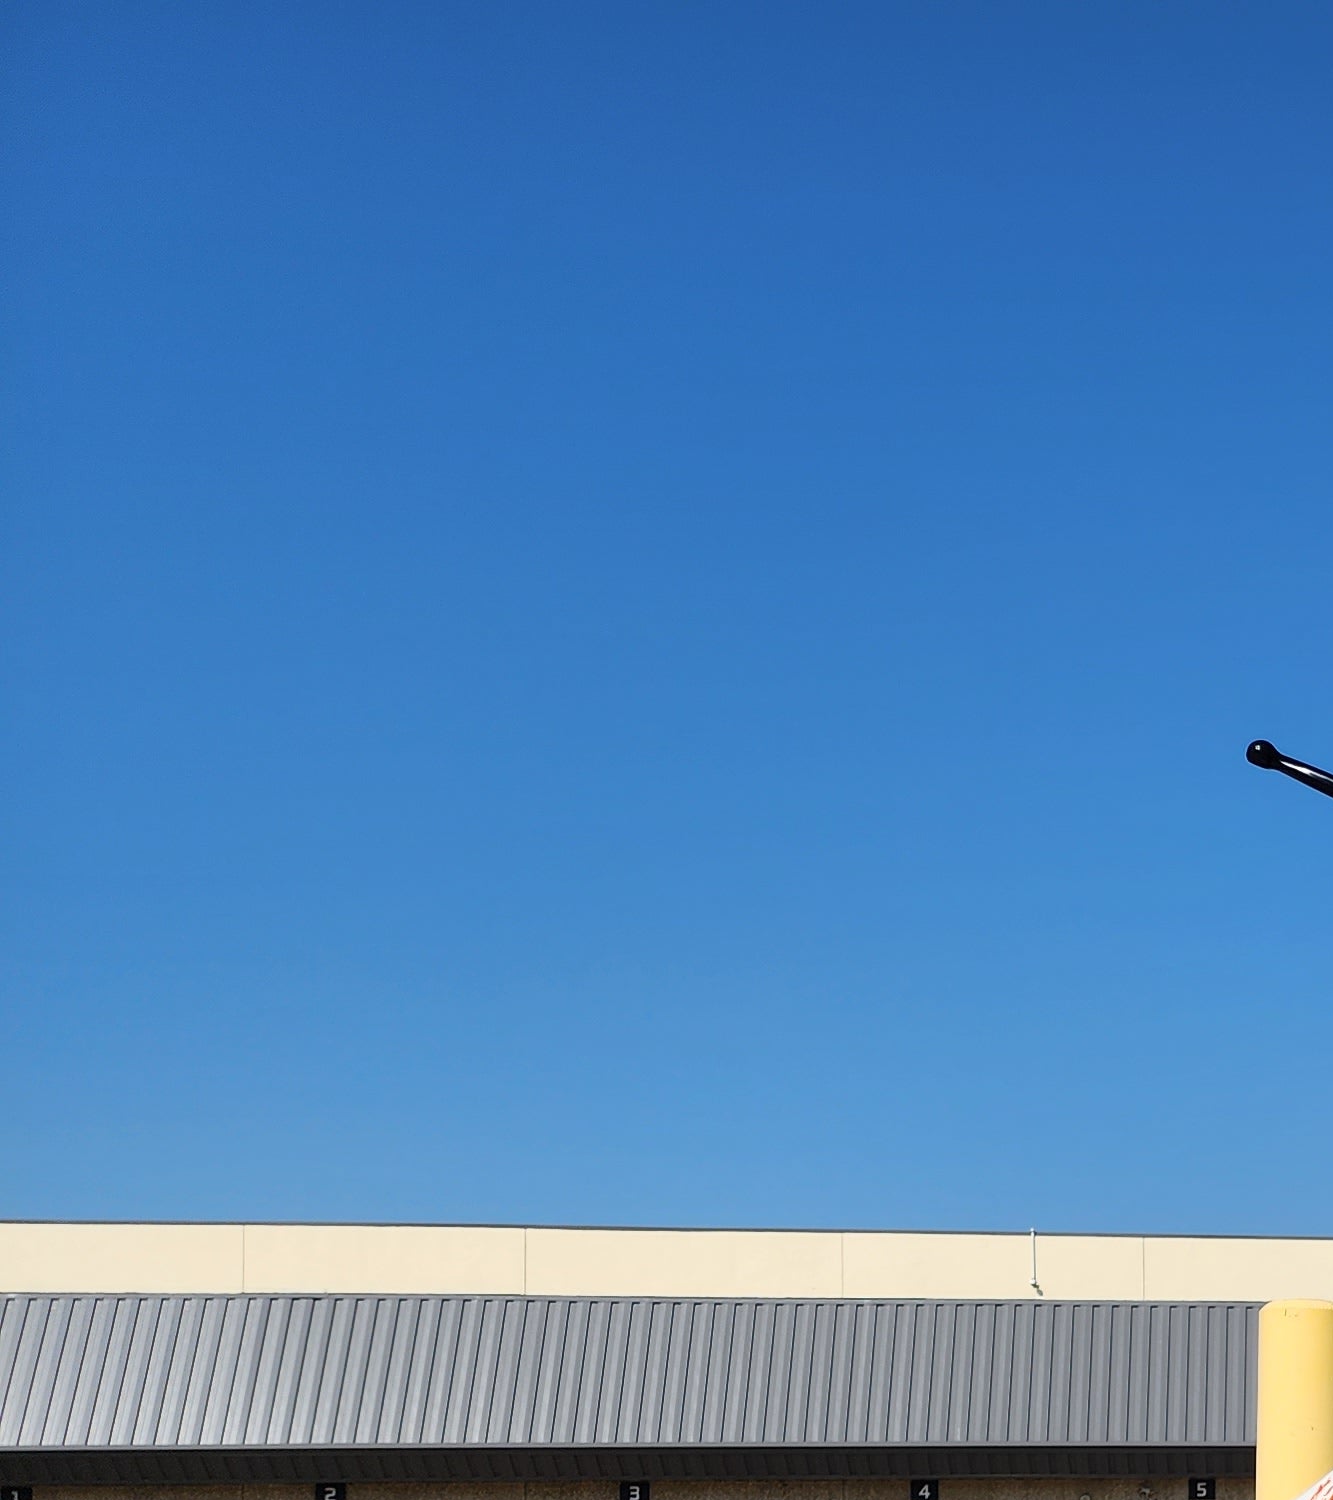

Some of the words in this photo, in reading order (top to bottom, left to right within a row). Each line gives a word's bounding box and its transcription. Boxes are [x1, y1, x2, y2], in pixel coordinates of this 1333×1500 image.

[629, 1485, 640, 1500] 3
[918, 1484, 931, 1500] 4
[1196, 1482, 1207, 1497] 5
